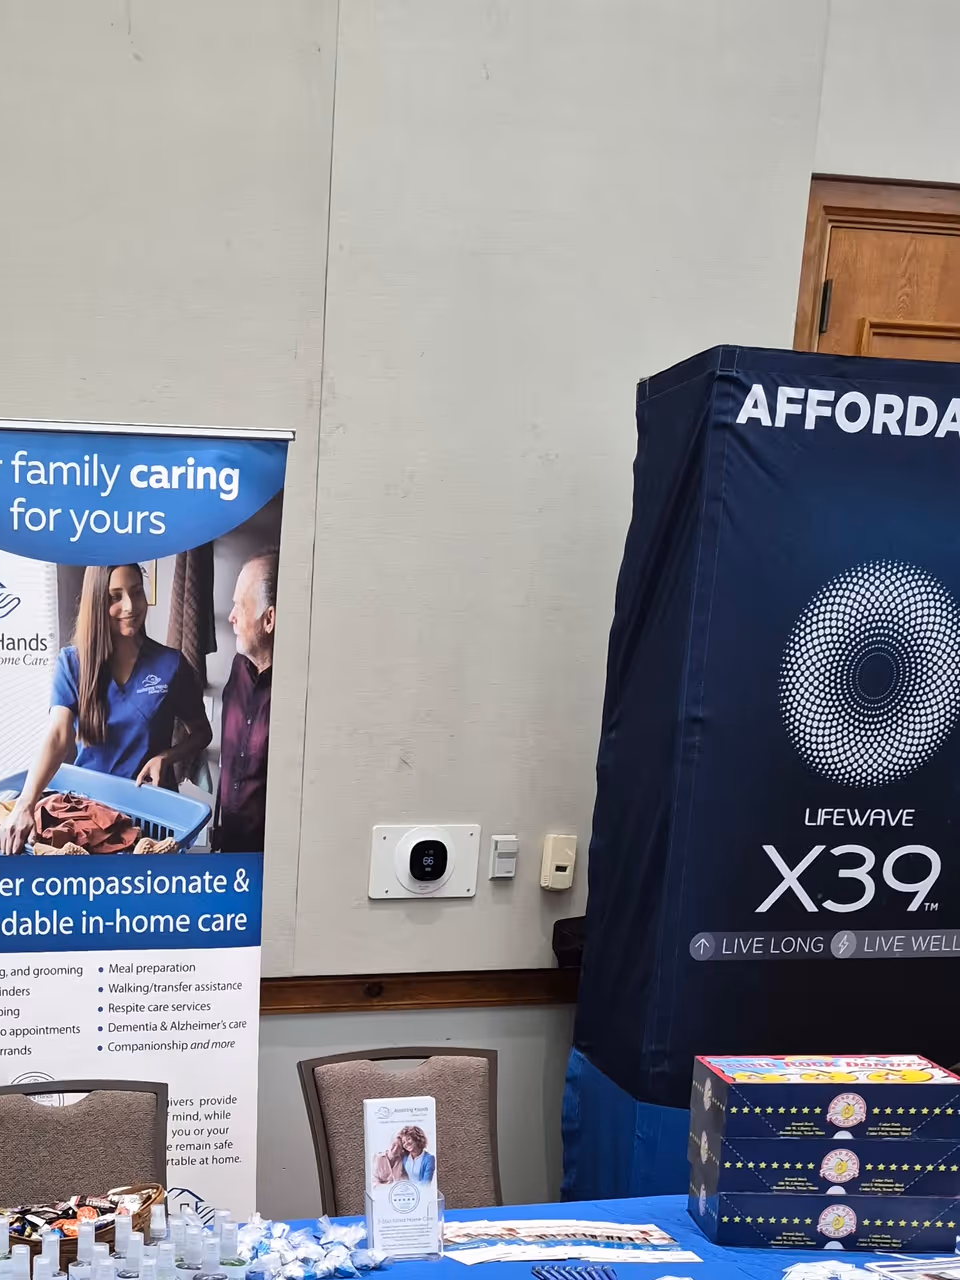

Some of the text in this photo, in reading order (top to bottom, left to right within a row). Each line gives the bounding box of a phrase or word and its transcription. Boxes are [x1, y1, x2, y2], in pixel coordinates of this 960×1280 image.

[735, 383, 960, 438] AFFORDA
[10, 450, 121, 497] family
[129, 456, 240, 501] caring
[9, 498, 166, 543] for yours
[23, 654, 49, 667] Care
[804, 808, 915, 826] LIFEWAVE
[423, 857, 434, 865] 66
[31, 869, 227, 901] compassionate
[233, 868, 250, 893] &
[81, 909, 190, 934] in-home
[197, 911, 247, 932] care
[722, 936, 824, 954] LIVE LONG
[864, 935, 960, 953] LIVE WELL
[10, 966, 30, 977] and
[32, 965, 83, 978] grooming
[108, 962, 196, 976] Meal preparation
[108, 980, 243, 996] Walking/transfer assistance
[108, 1002, 211, 1015] Respite care services
[9, 1024, 81, 1039] appointments
[108, 1022, 158, 1033] Dementia
[160, 1022, 168, 1032] &
[228, 1020, 247, 1030] care
[107, 1040, 235, 1053] Companionship and more
[167, 1095, 237, 1108] ivers provide
[172, 1111, 202, 1122] mind,
[204, 1110, 231, 1120] while
[172, 1127, 229, 1139] you or your
[176, 1143, 211, 1151] remain
[214, 1139, 233, 1150] safe
[166, 1155, 241, 1166] rtable at home.
